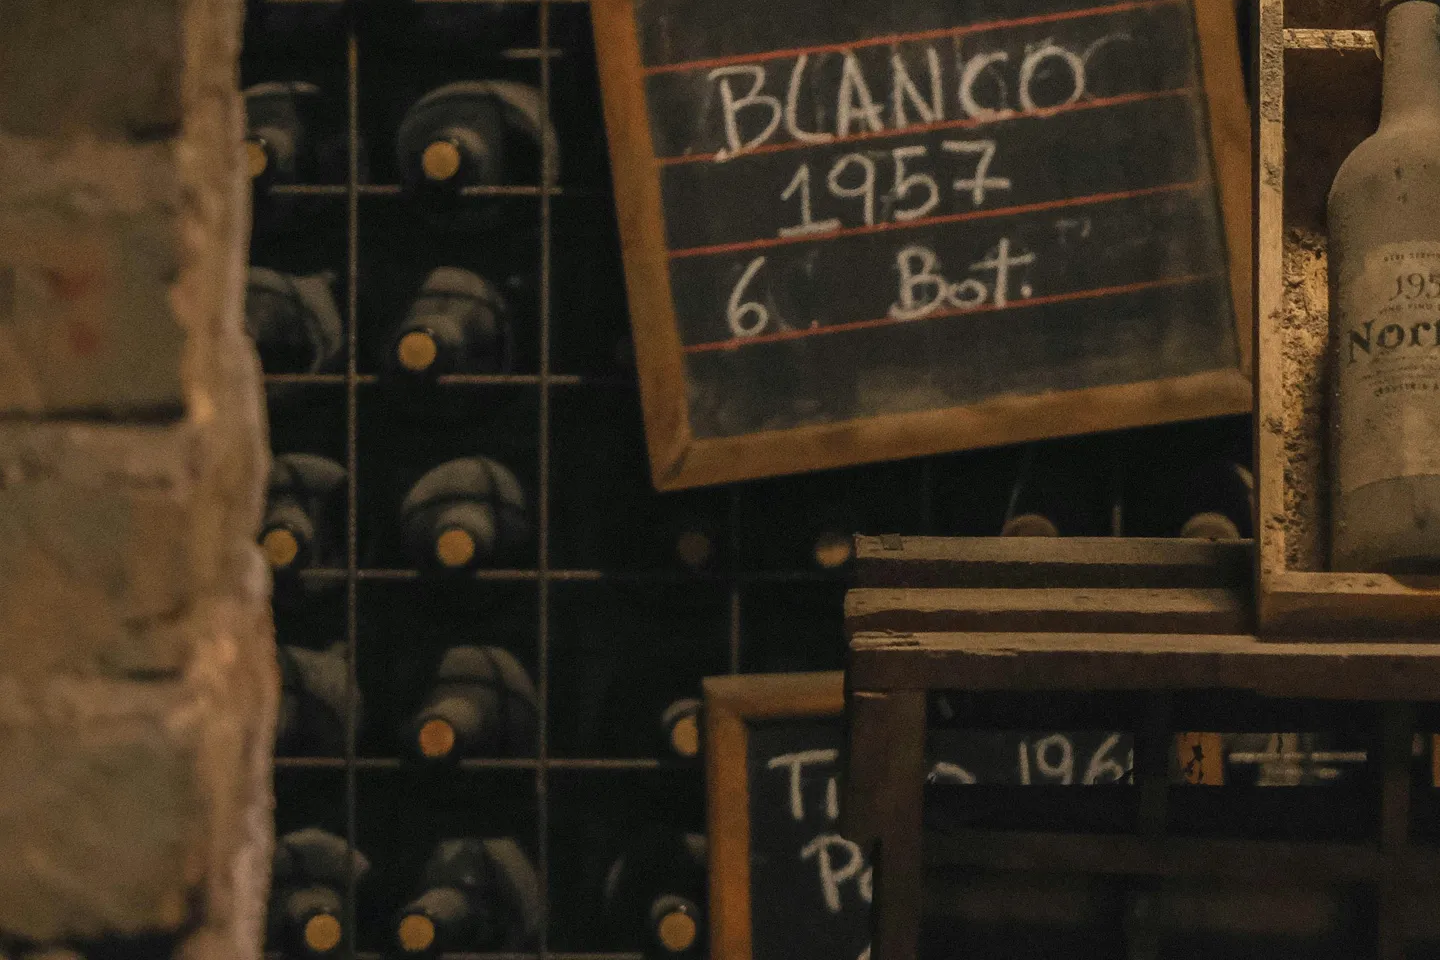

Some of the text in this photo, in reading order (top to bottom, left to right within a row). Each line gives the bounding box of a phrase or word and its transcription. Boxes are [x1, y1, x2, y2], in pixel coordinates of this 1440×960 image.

[707, 44, 1086, 163] BLANCO
[776, 140, 1011, 238] 1957
[727, 238, 1036, 339] 6 Bot.
